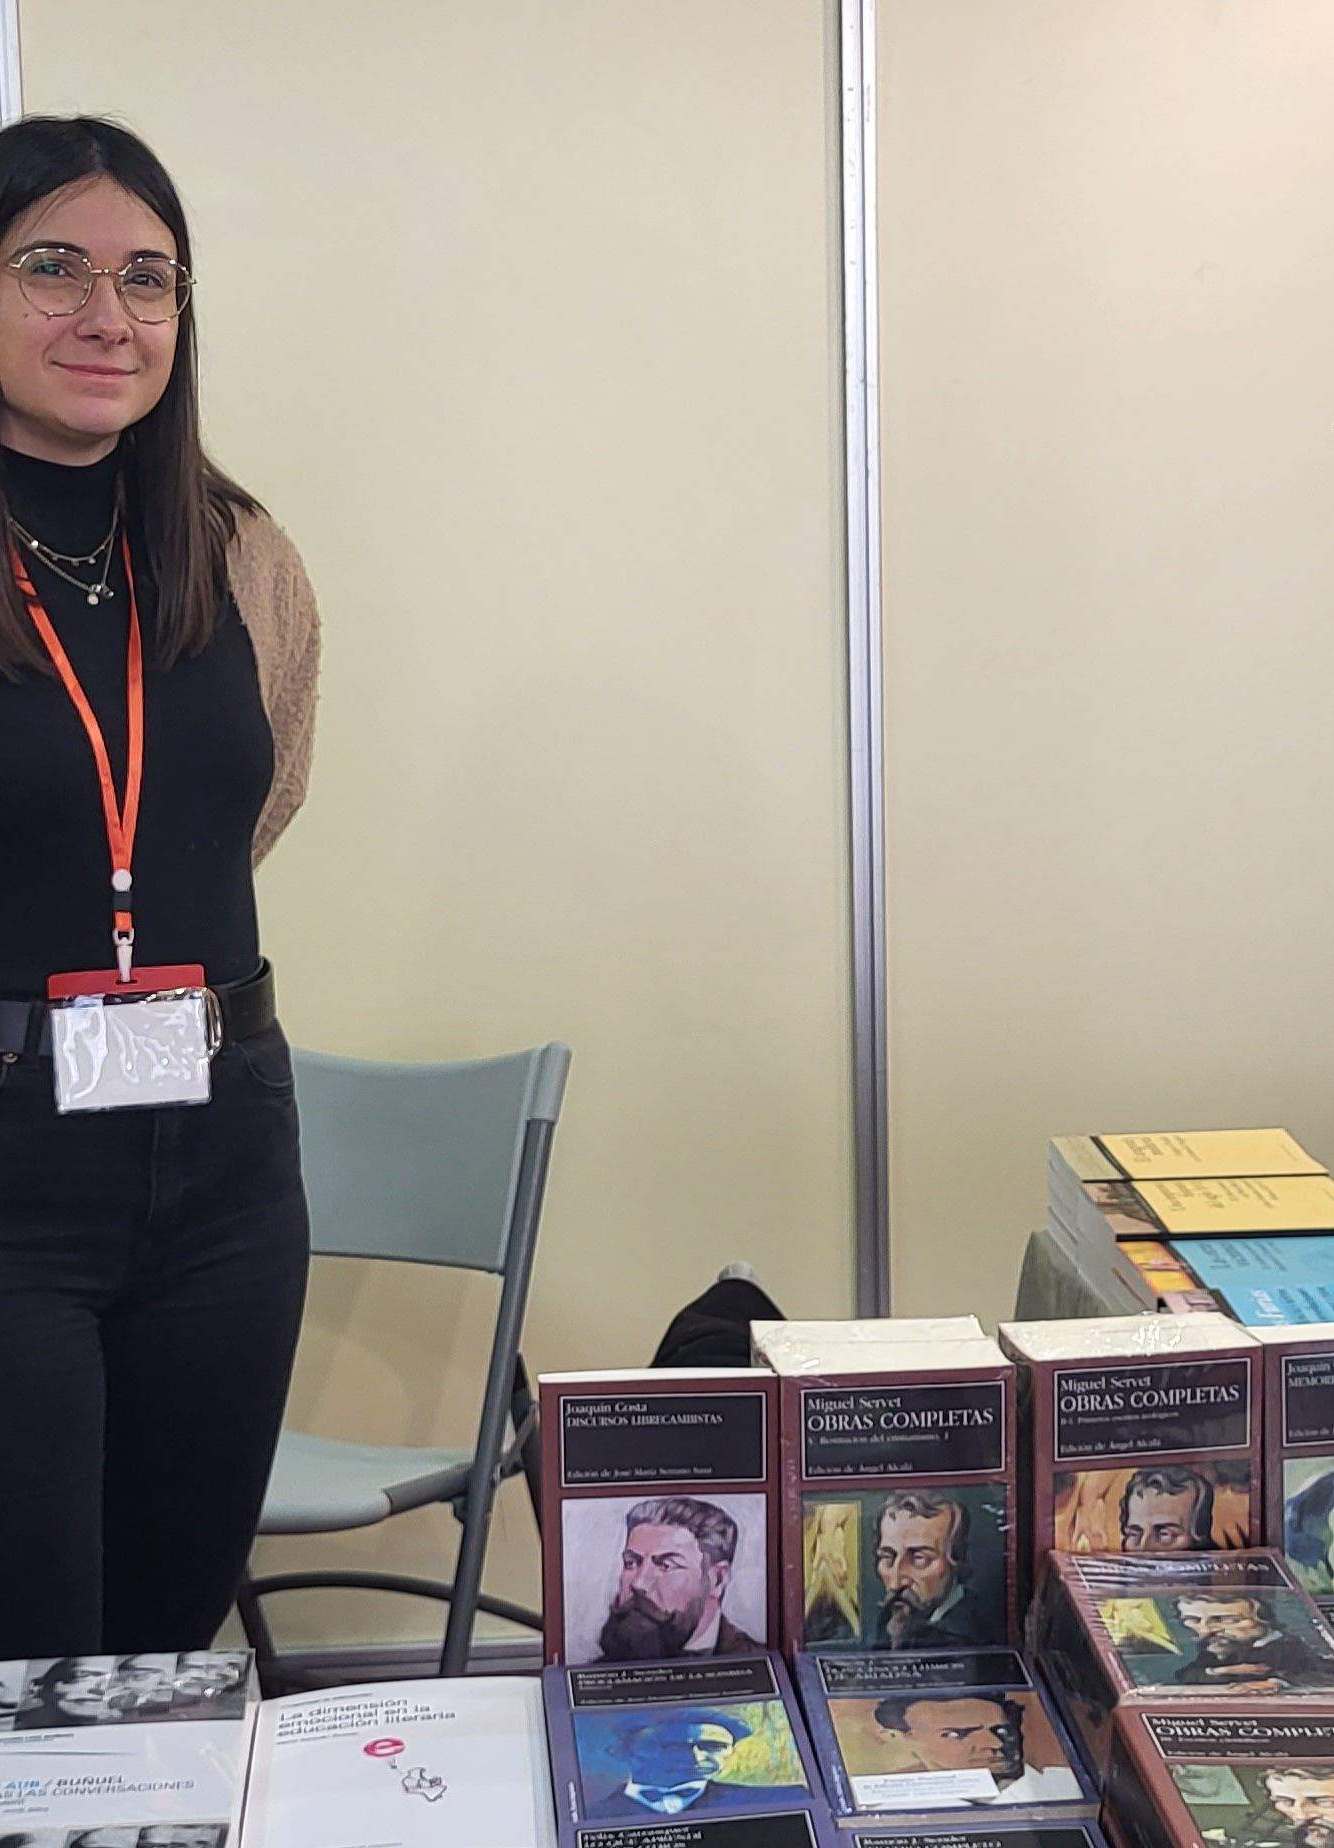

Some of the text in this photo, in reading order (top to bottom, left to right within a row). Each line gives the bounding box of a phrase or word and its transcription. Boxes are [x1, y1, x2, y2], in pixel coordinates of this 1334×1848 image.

[1060, 1375, 1152, 1394] Miguel Servet
[615, 1401, 648, 1413] Costa
[807, 1396, 902, 1413] Miguel Servet
[1060, 1385, 1240, 1412] OBRAS COMPLETAS
[566, 1413, 724, 1428] DISCURSOS LIBRECAMBISTAS
[807, 1408, 995, 1431] OBRAS COMPLETAS
[278, 1704, 430, 1729] emocional en la
[279, 1710, 303, 1722] La
[309, 1699, 409, 1718] dimensión
[277, 1710, 456, 1738] educación literaria
[1152, 1718, 1258, 1727] Miguel Servet
[1155, 1726, 1232, 1737] OBRAS
[5, 1781, 40, 1791] AUB
[56, 1773, 125, 1788] BUÑUEL
[17, 1789, 47, 1800] LAS
[52, 1780, 196, 1797] CONVERSACIONES
